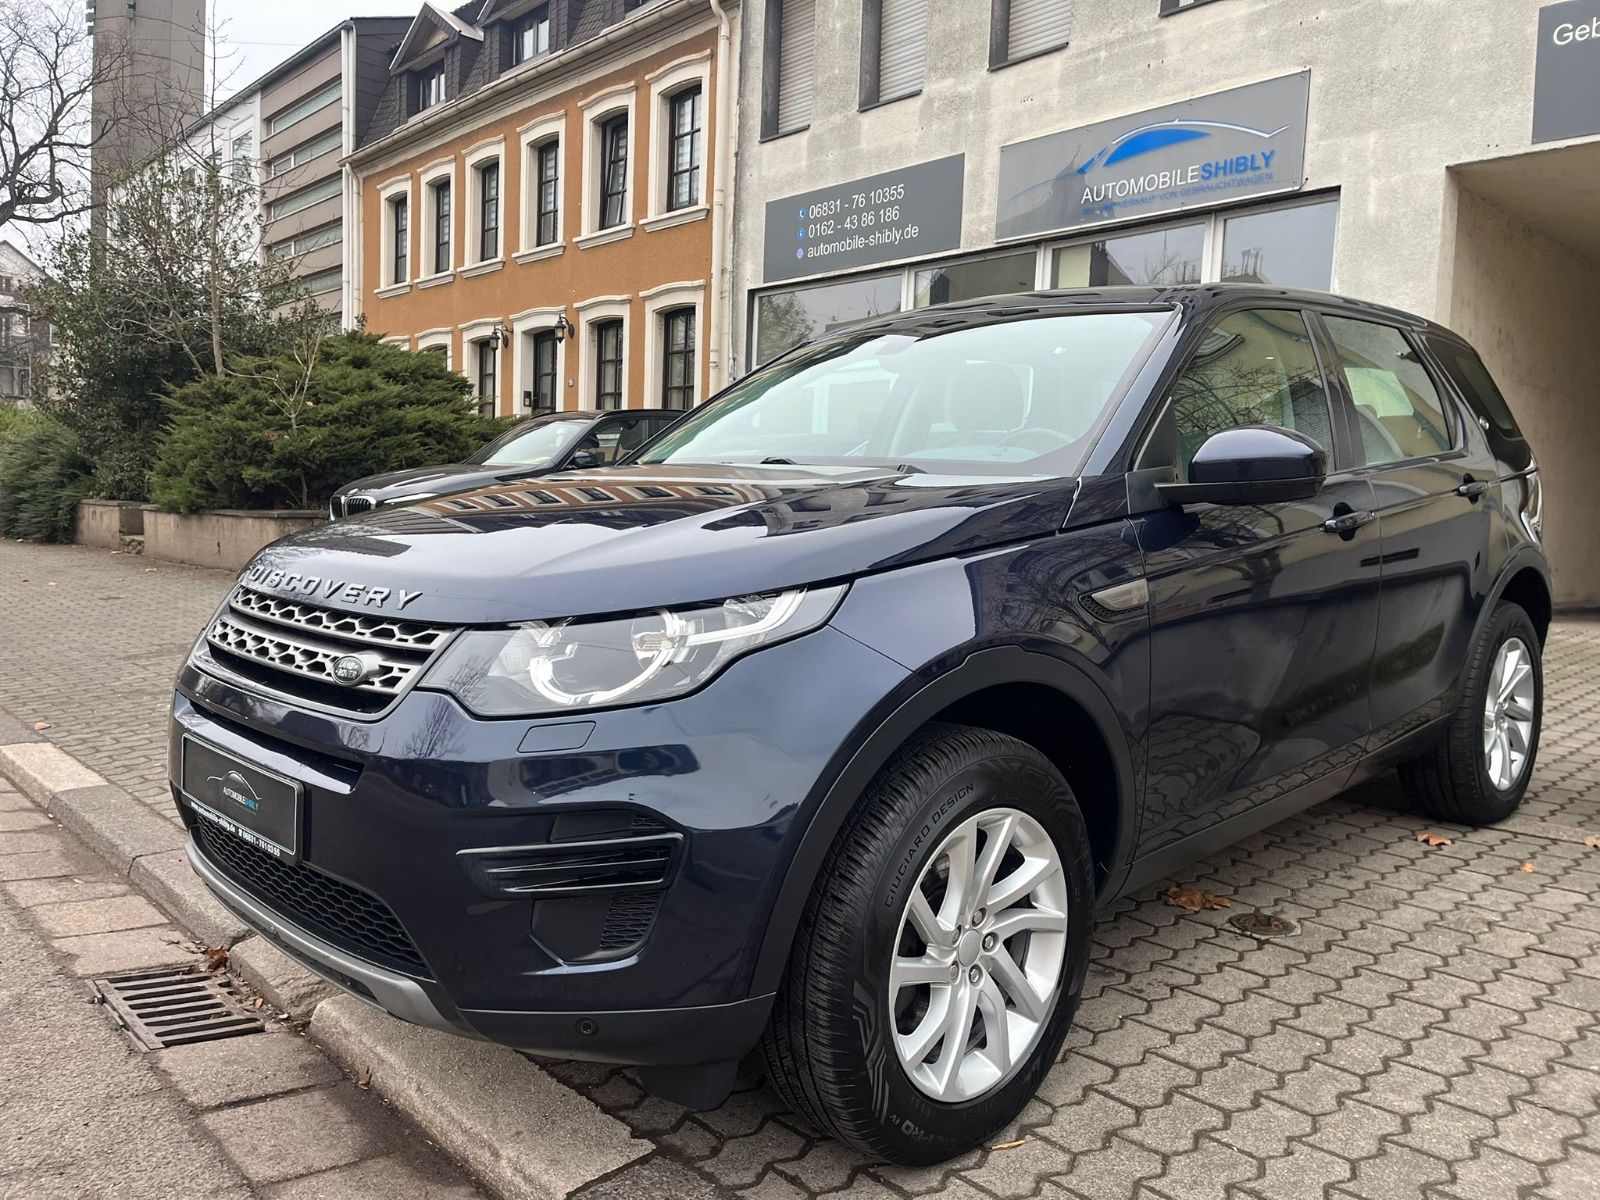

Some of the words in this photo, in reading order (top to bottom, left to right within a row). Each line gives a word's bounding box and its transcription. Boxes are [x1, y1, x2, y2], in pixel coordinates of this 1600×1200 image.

[809, 199, 841, 219] 06831
[852, 193, 866, 210] 76
[869, 184, 905, 205] 10355
[808, 220, 835, 238] 0162
[844, 215, 858, 230] 43
[861, 211, 875, 227] 86
[879, 205, 900, 223] 186
[807, 223, 919, 258] automobile-shibly.de
[248, 565, 423, 610] DISCOVERY
[338, 668, 357, 679] ROVER
[931, 783, 975, 825] DESIGN
